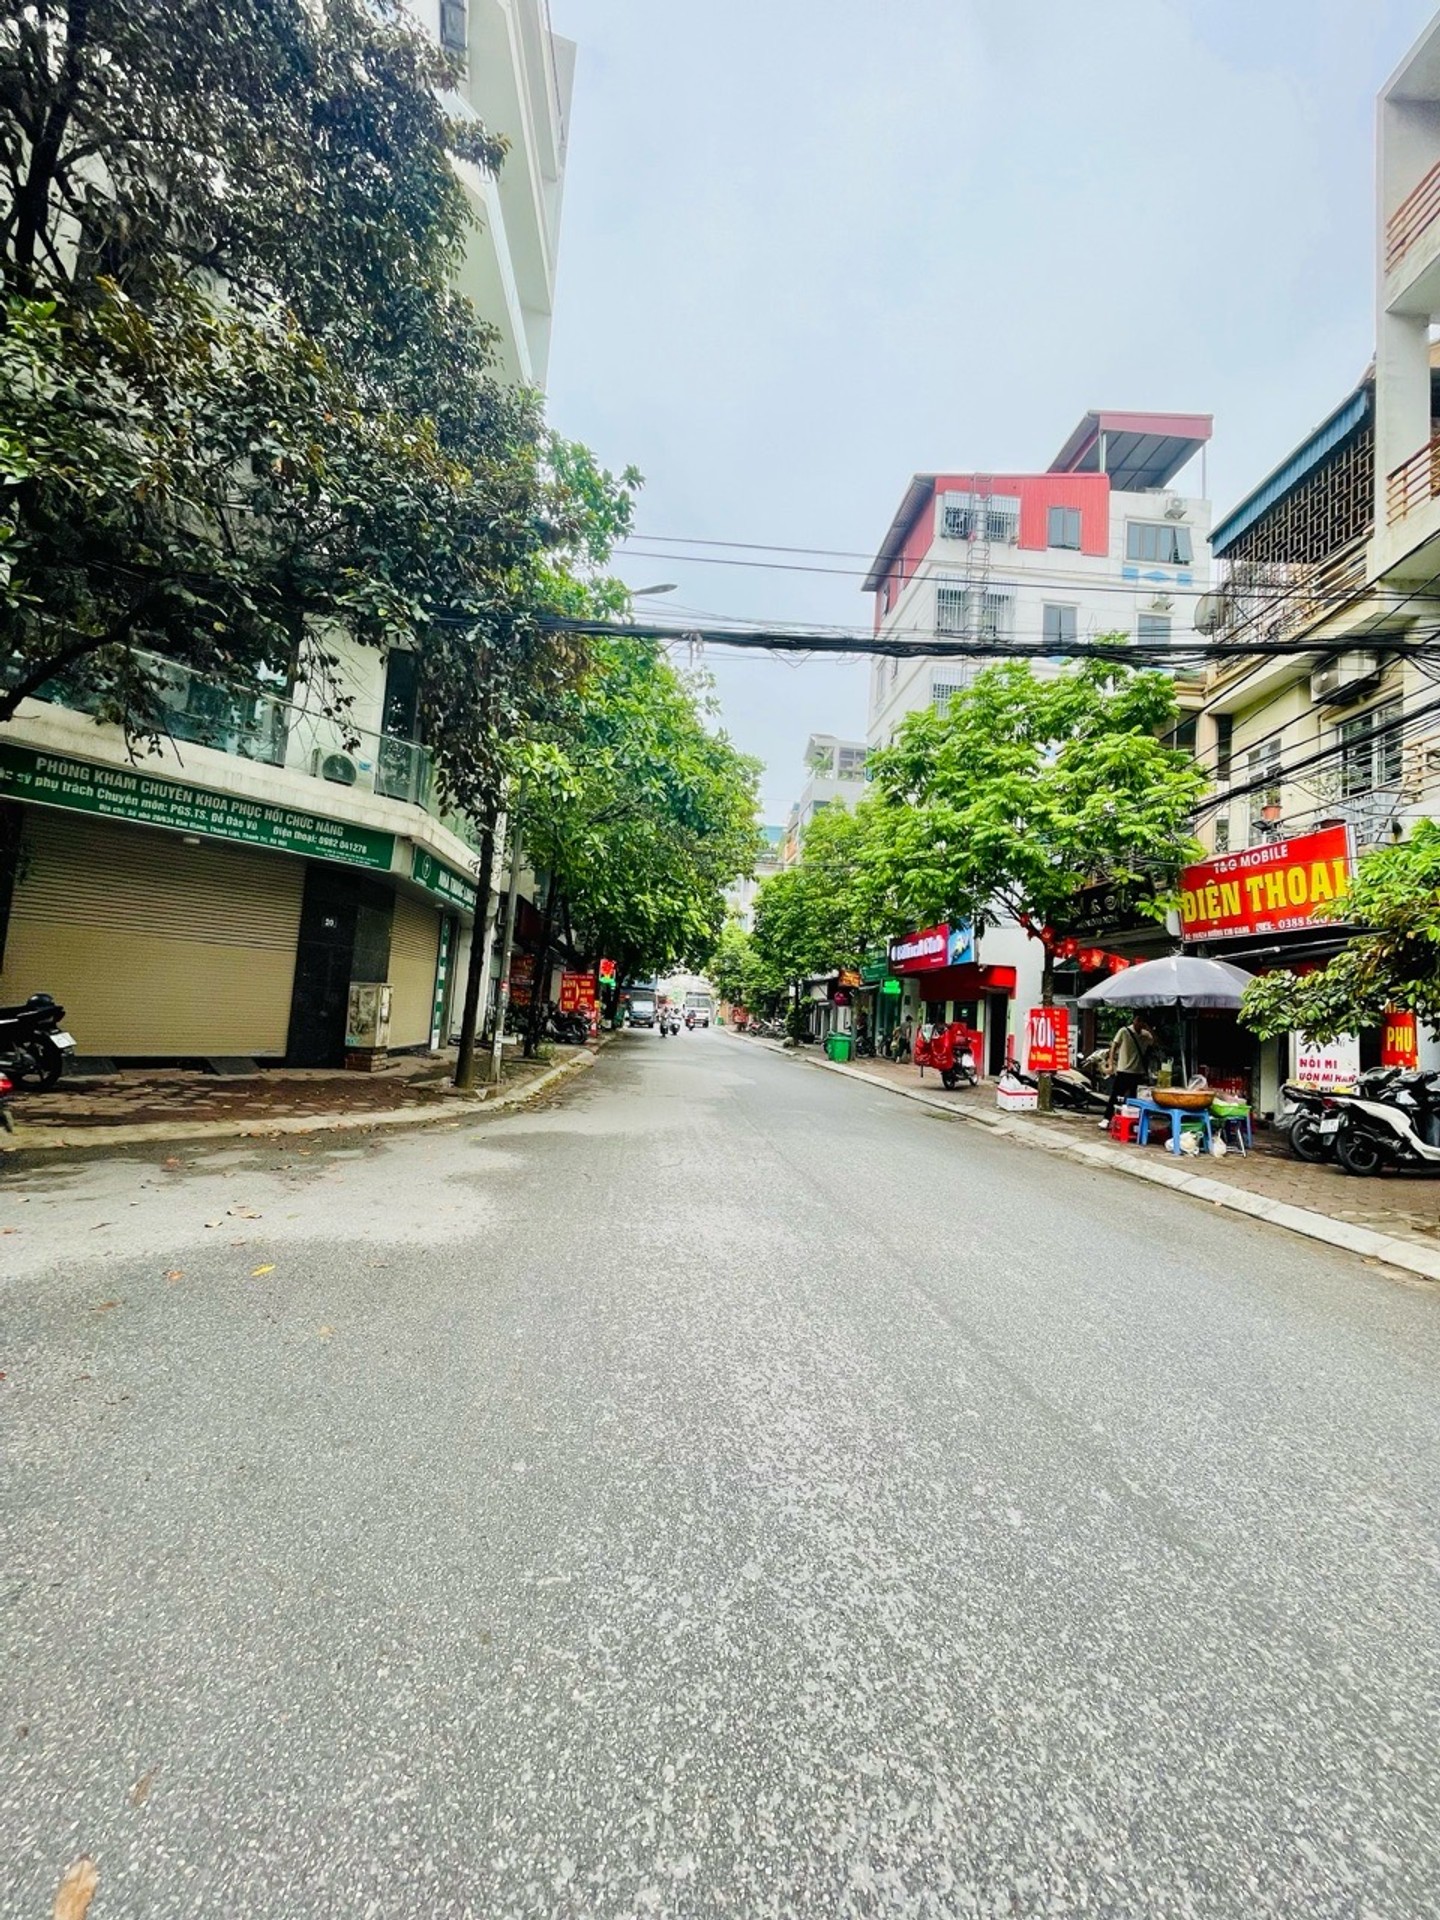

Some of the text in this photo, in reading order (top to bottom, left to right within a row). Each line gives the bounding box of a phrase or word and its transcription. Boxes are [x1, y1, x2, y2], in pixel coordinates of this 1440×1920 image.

[35, 776, 59, 792] phụ
[62, 781, 94, 796] trách
[96, 787, 139, 806] Chuyên
[141, 798, 168, 812] môn:
[36, 757, 344, 837] PHÒNG KHÁM CHUYÊN KHOA PHỤC HỒI CHỨC NĂNG
[1240, 844, 1289, 867] MOBILE
[1182, 879, 1242, 925] ĐIỆN
[1387, 1026, 1413, 1058] PHỤ
